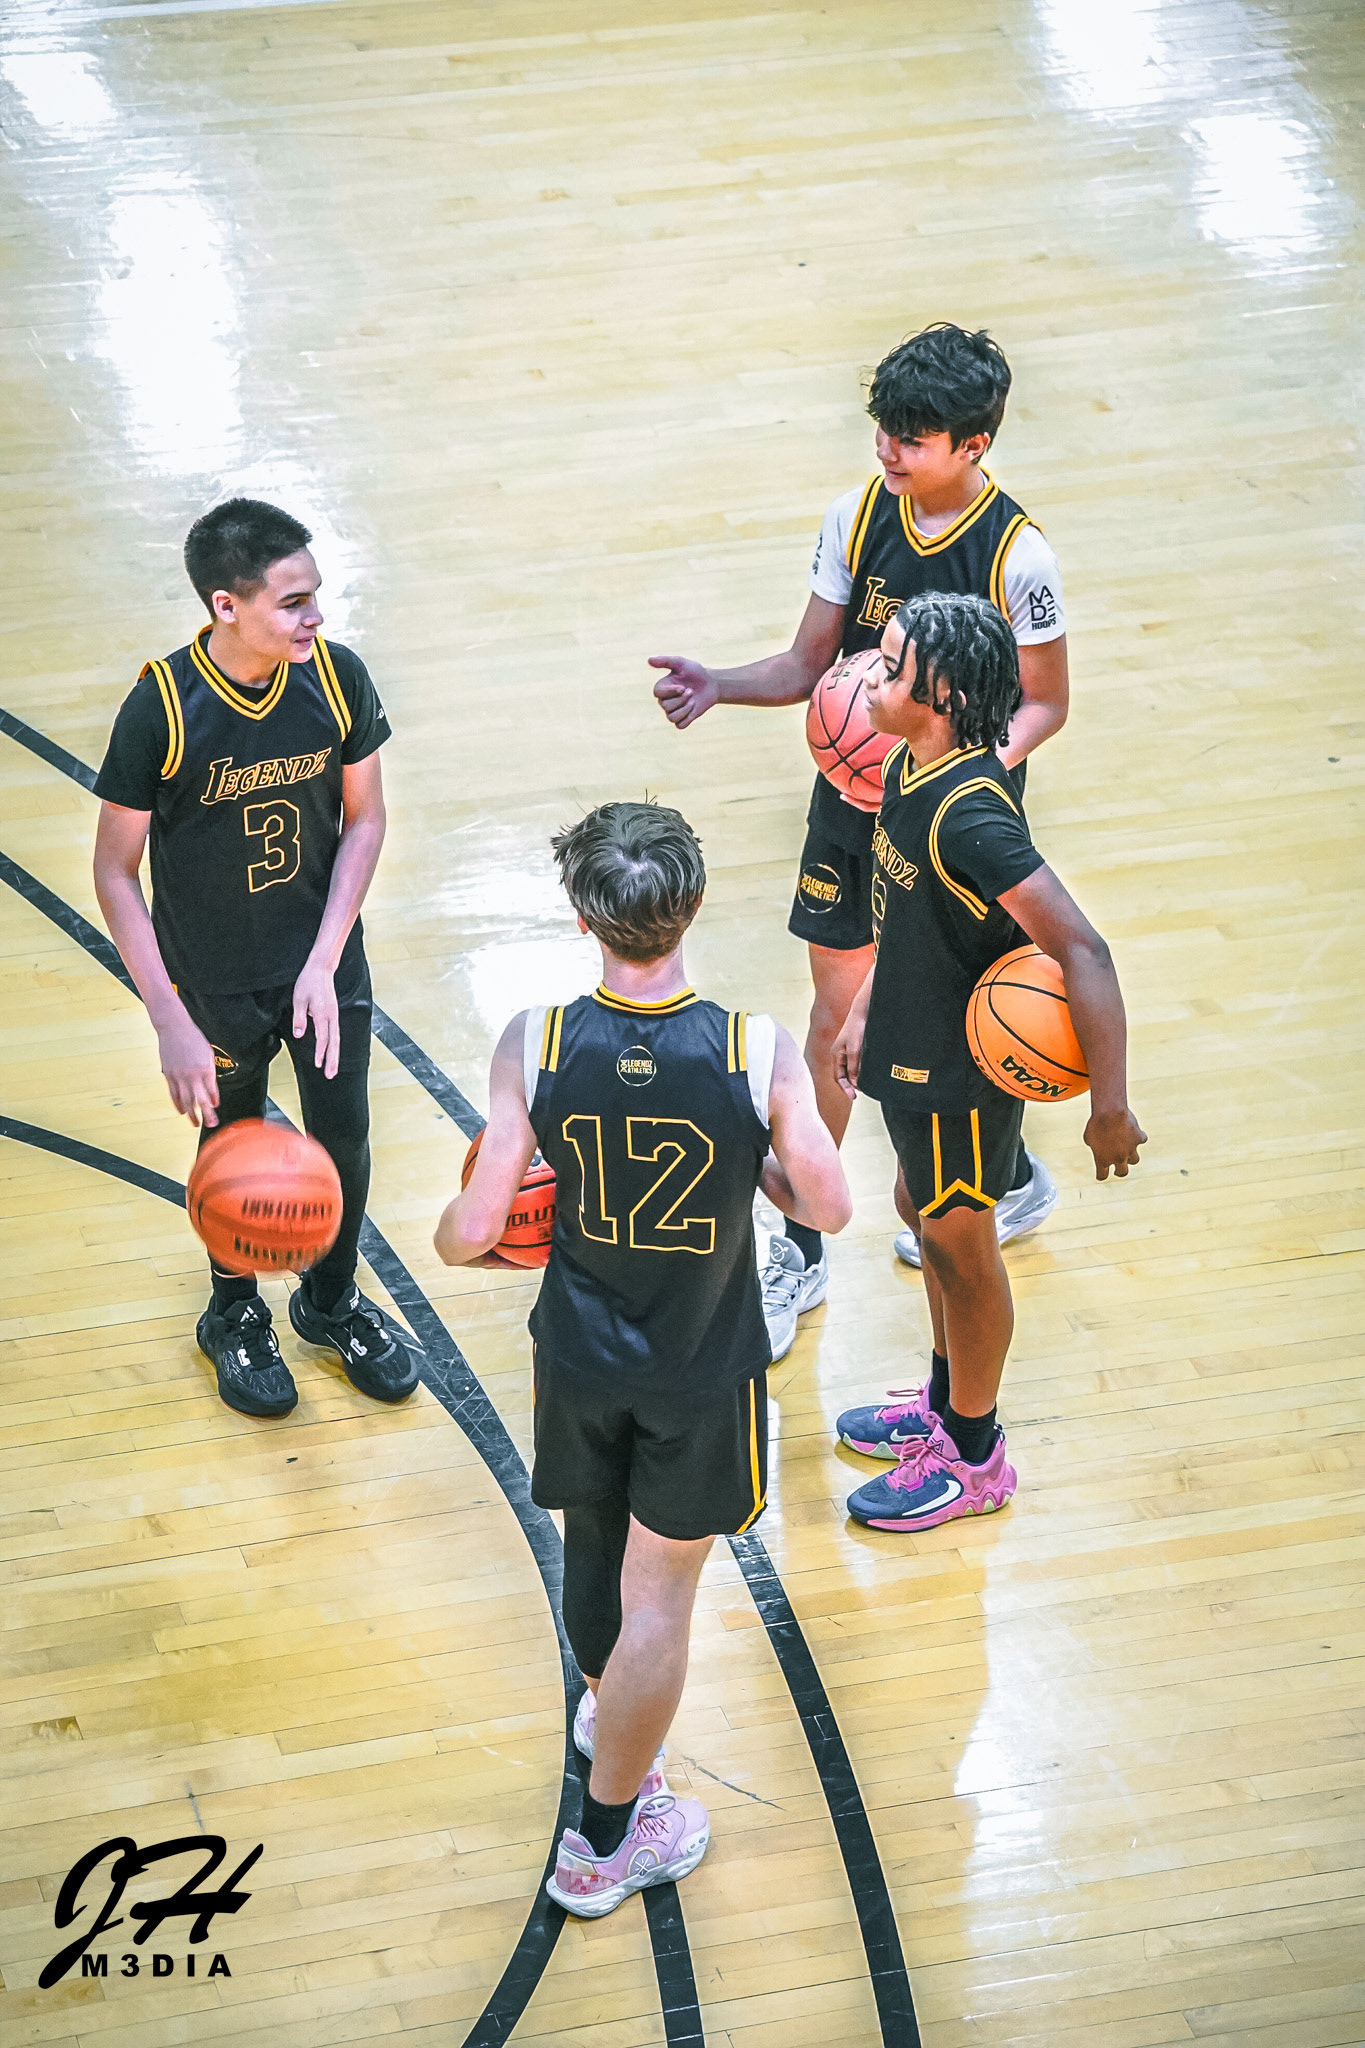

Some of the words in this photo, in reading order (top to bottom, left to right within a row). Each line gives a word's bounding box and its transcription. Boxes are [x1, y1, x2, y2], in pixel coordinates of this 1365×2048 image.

[857, 576, 905, 630] LEG
[1031, 616, 1057, 630] HOOPS
[200, 746, 332, 805] LEGENDZ
[244, 799, 300, 893] 3
[627, 1059, 653, 1068] LEGENDZ
[627, 1067, 653, 1075] ATHLETICS
[1001, 1055, 1069, 1097] NCAA
[562, 1114, 716, 1255] 12
